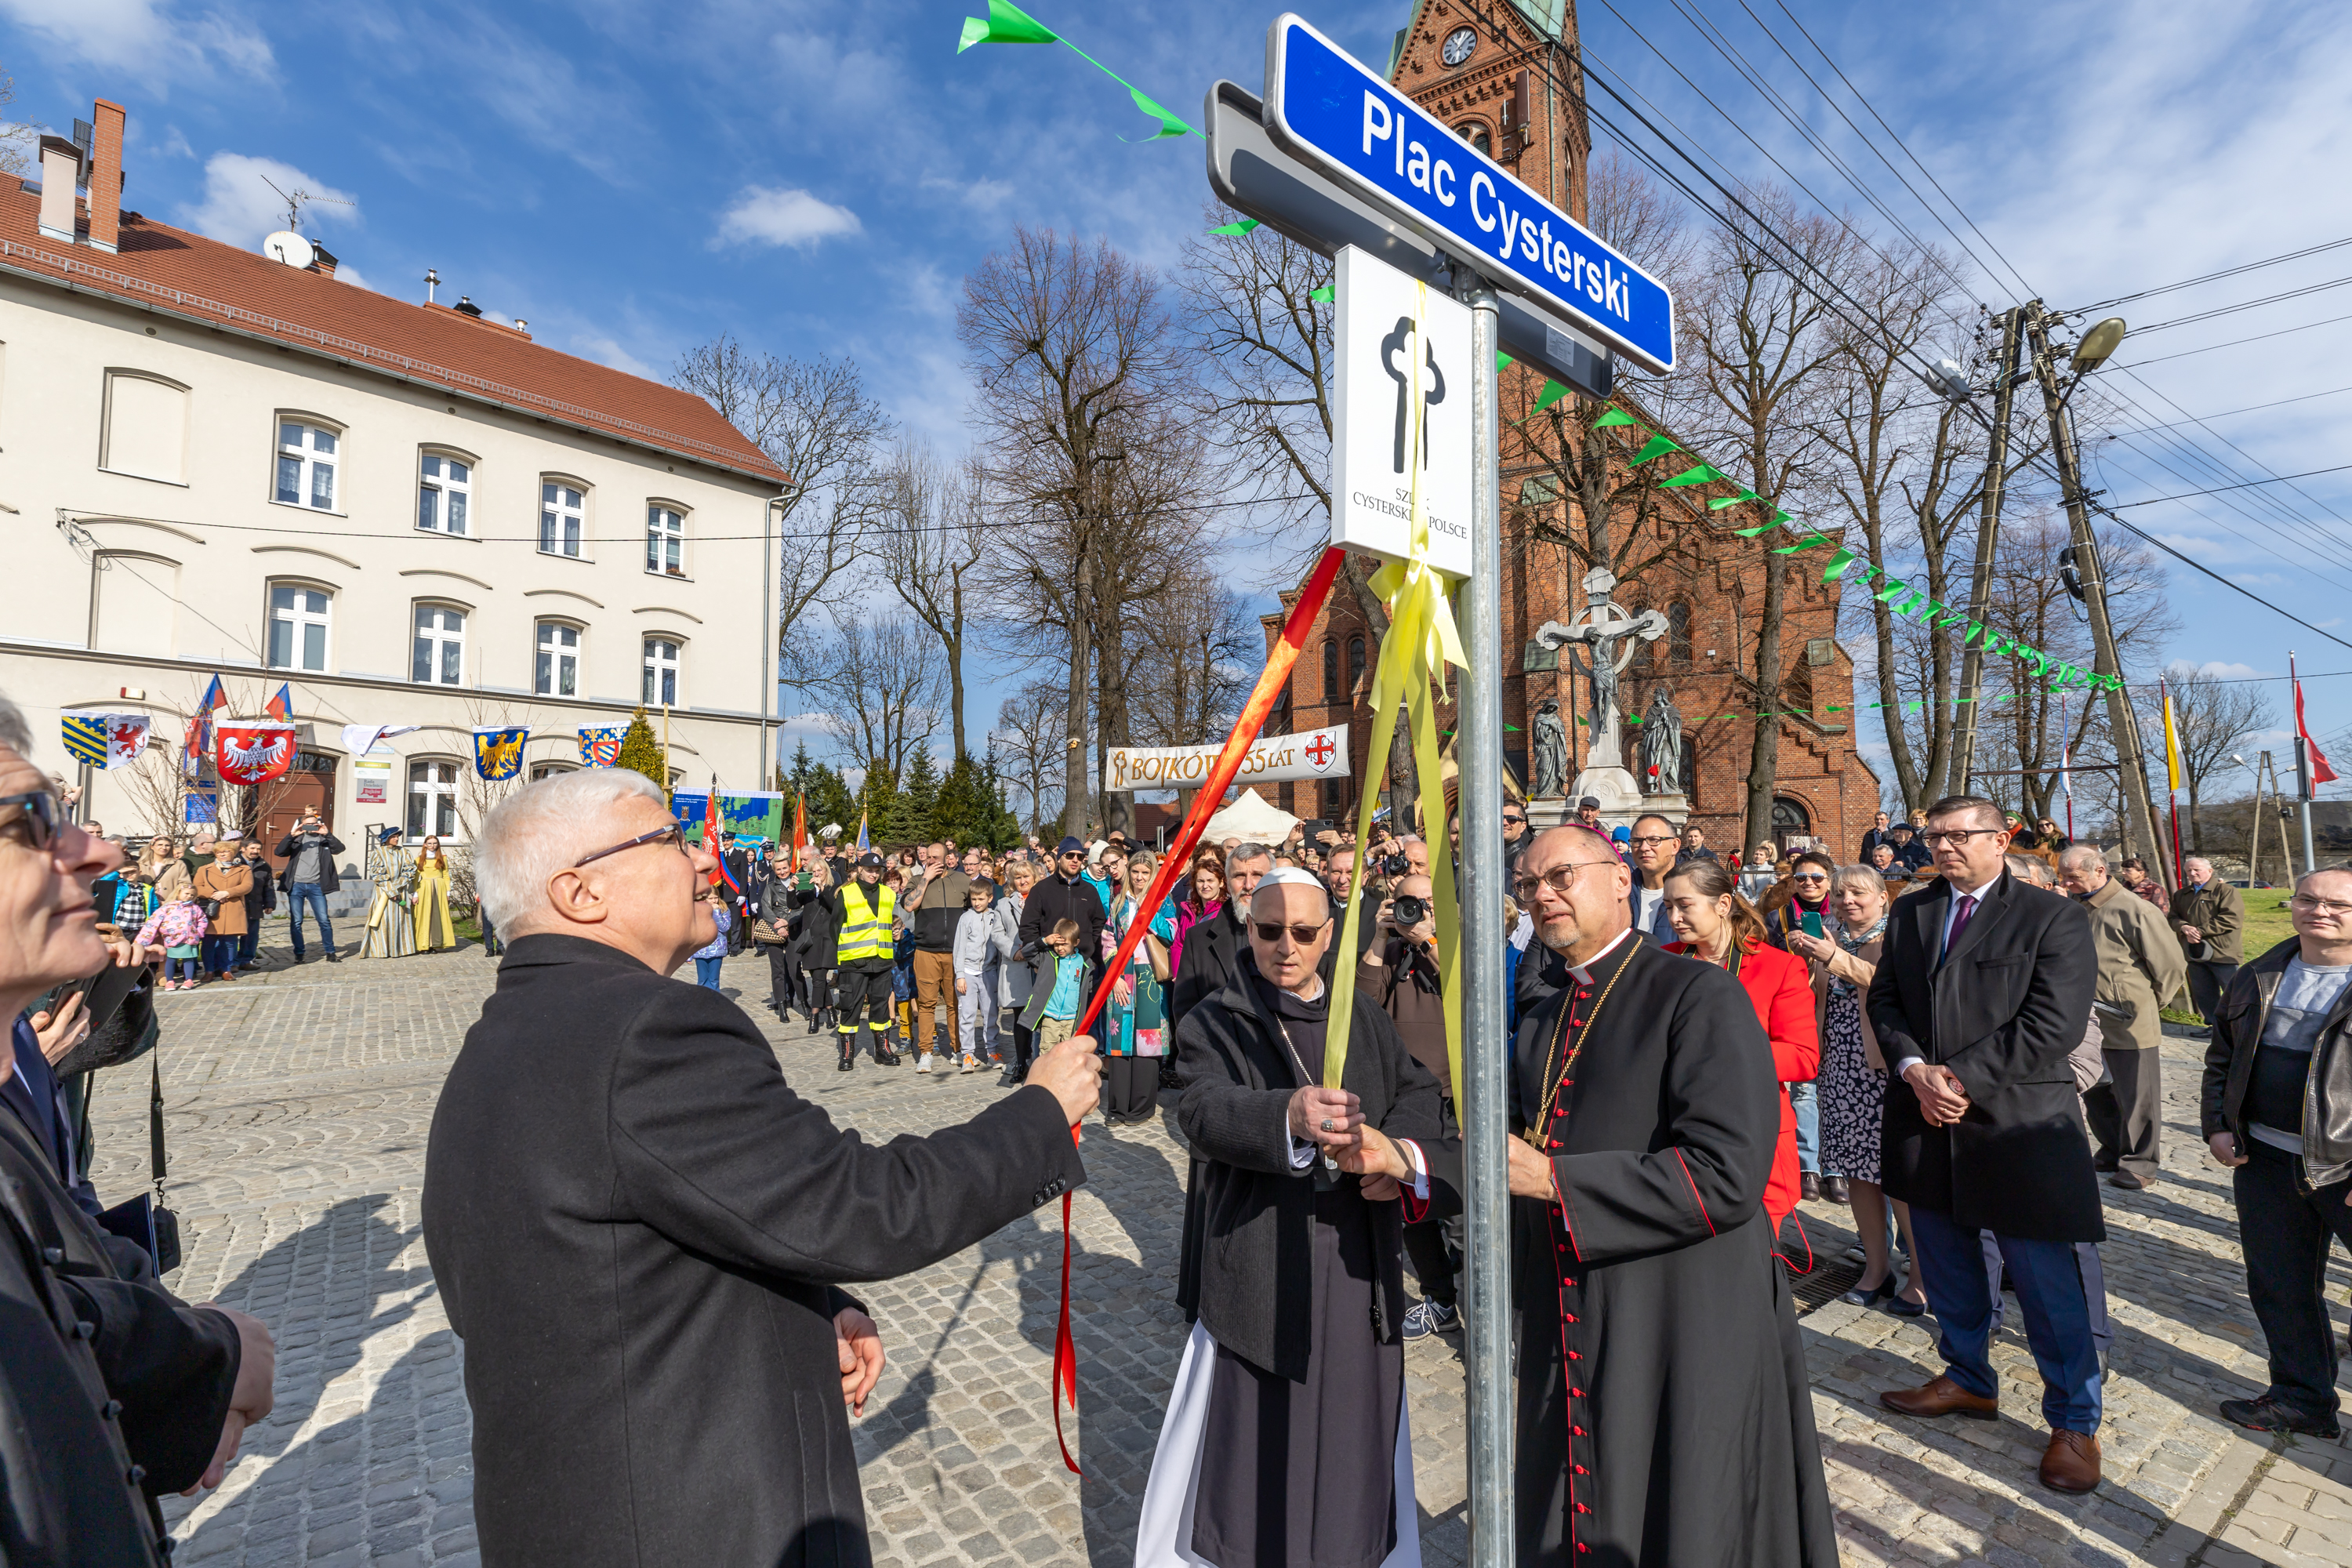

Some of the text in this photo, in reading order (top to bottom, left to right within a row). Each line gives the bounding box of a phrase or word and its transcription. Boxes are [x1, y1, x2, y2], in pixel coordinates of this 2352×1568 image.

[1363, 89, 1630, 322] Plac Cysterski
[1353, 492, 1467, 539] CYSTERSKI POLSCE
[1396, 488, 1430, 510] SZL
[1236, 748, 1266, 775] 55
[1268, 749, 1294, 768] LAT
